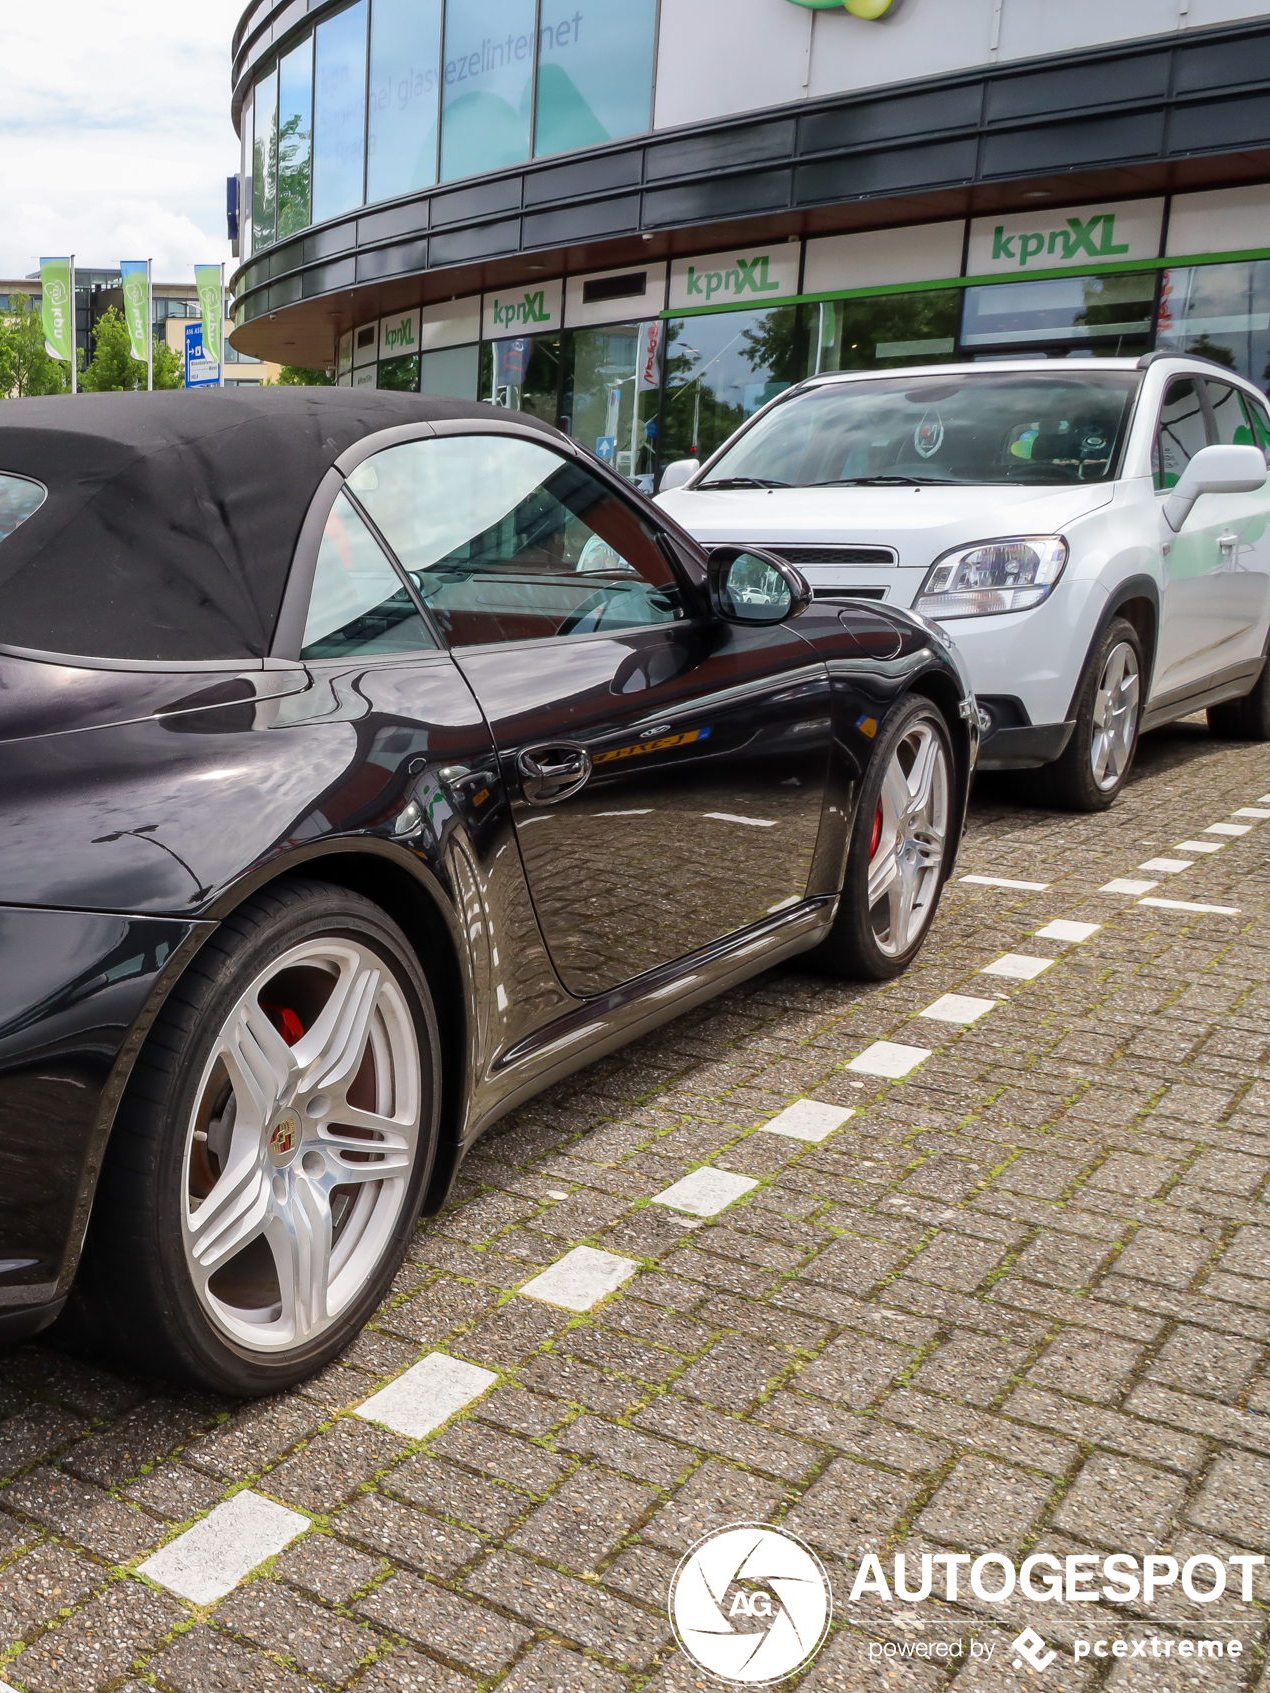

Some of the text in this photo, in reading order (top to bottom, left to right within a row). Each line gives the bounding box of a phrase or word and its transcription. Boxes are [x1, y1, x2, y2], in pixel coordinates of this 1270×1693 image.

[991, 213, 1130, 266] kpnXL
[686, 255, 779, 300] kpnXL
[493, 290, 551, 329] kpnXL
[385, 317, 415, 350] kpnXL
